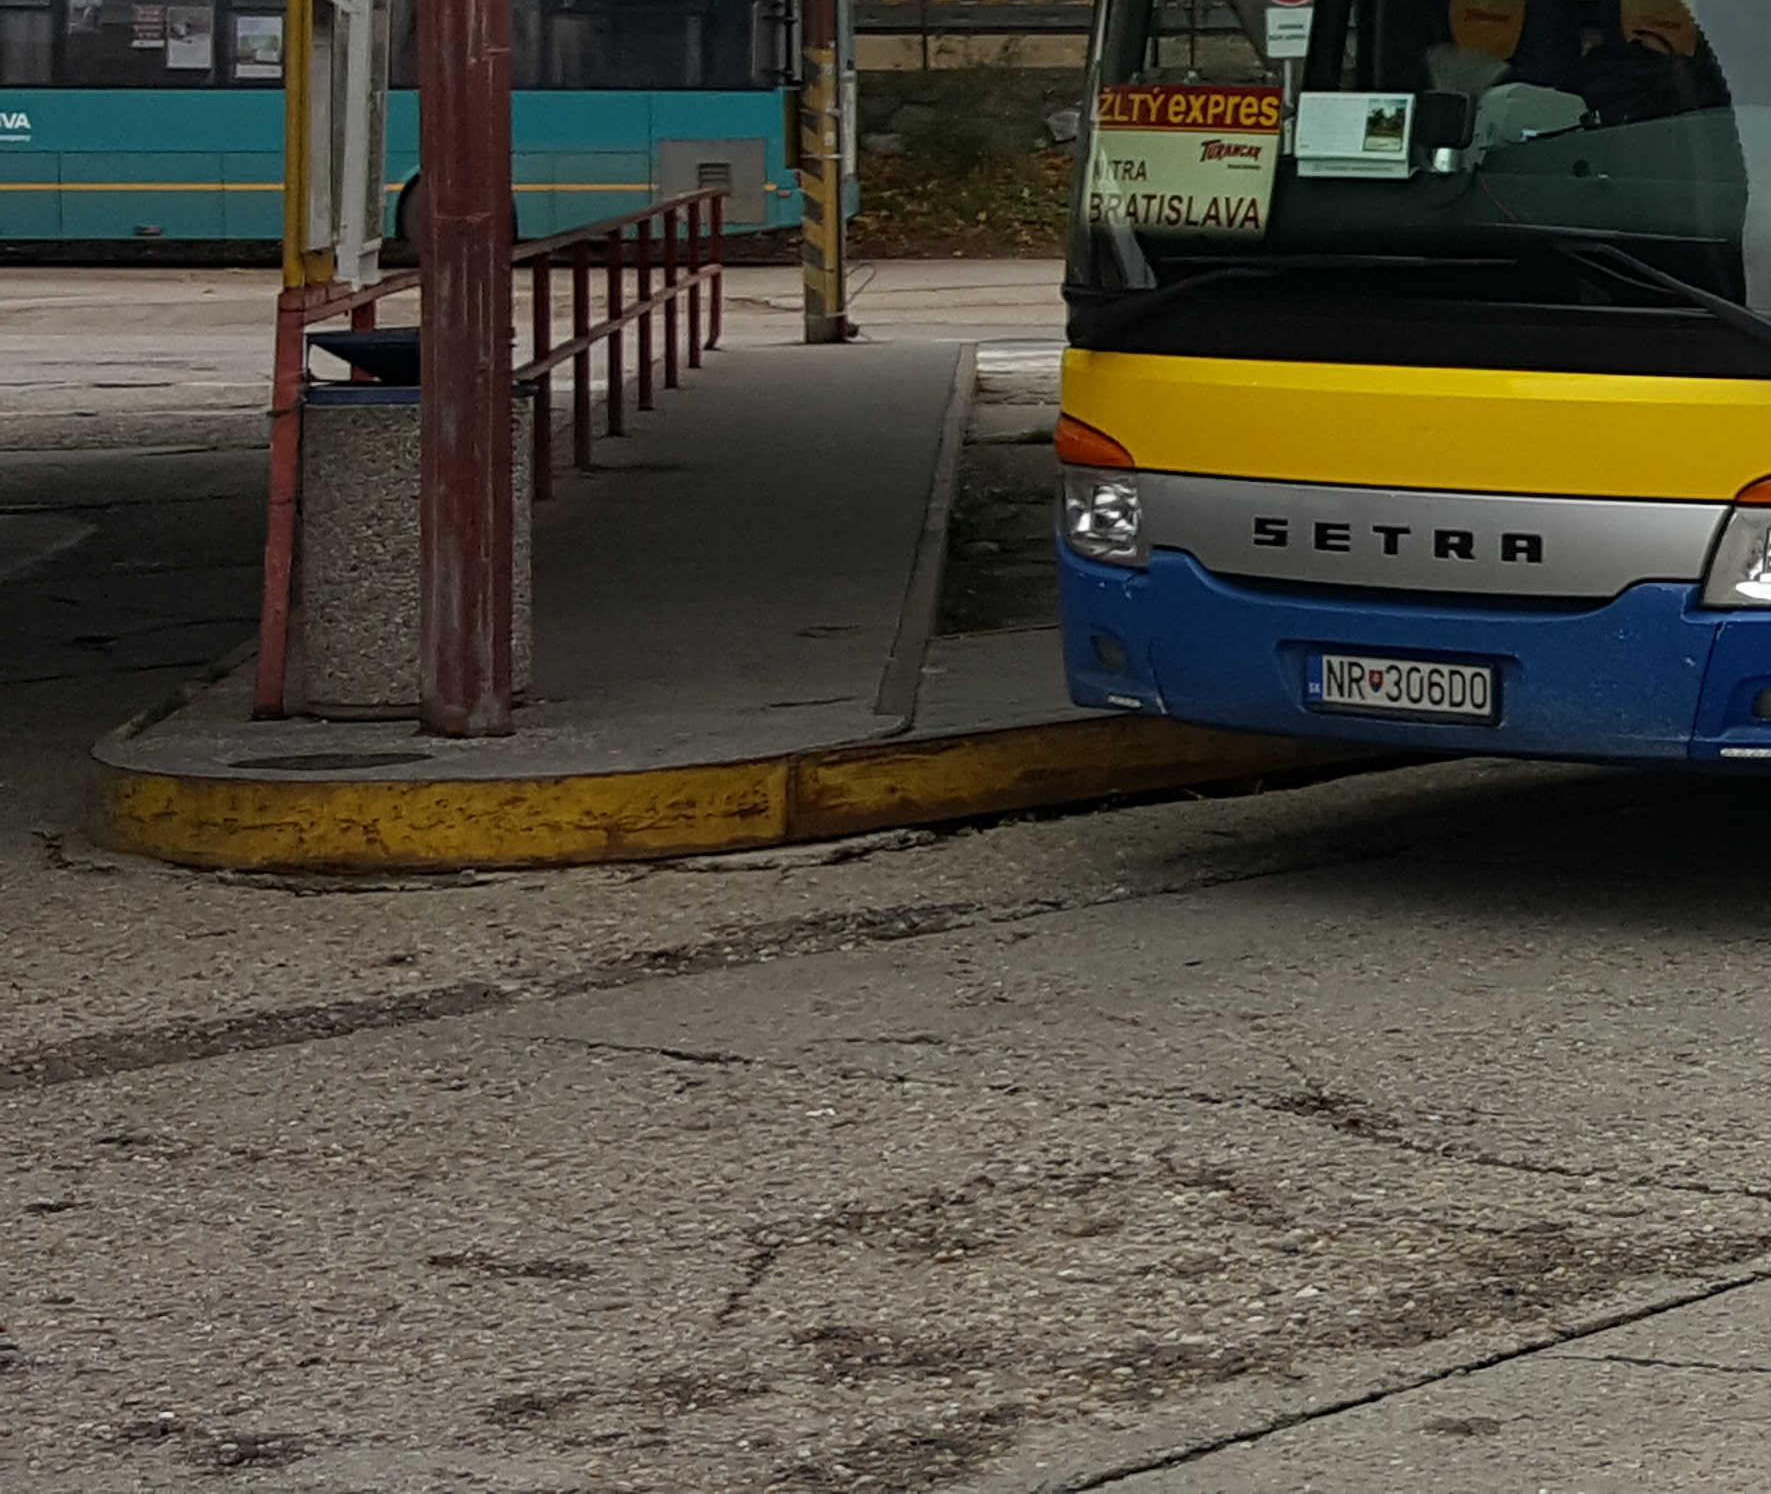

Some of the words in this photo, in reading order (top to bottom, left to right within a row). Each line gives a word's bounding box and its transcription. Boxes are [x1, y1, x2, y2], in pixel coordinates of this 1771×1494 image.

[1098, 86, 1166, 123] ŽLTÝ
[1167, 93, 1281, 127] expres
[1089, 192, 1261, 230] BRATISLAVA
[1252, 516, 1543, 564] SETRA
